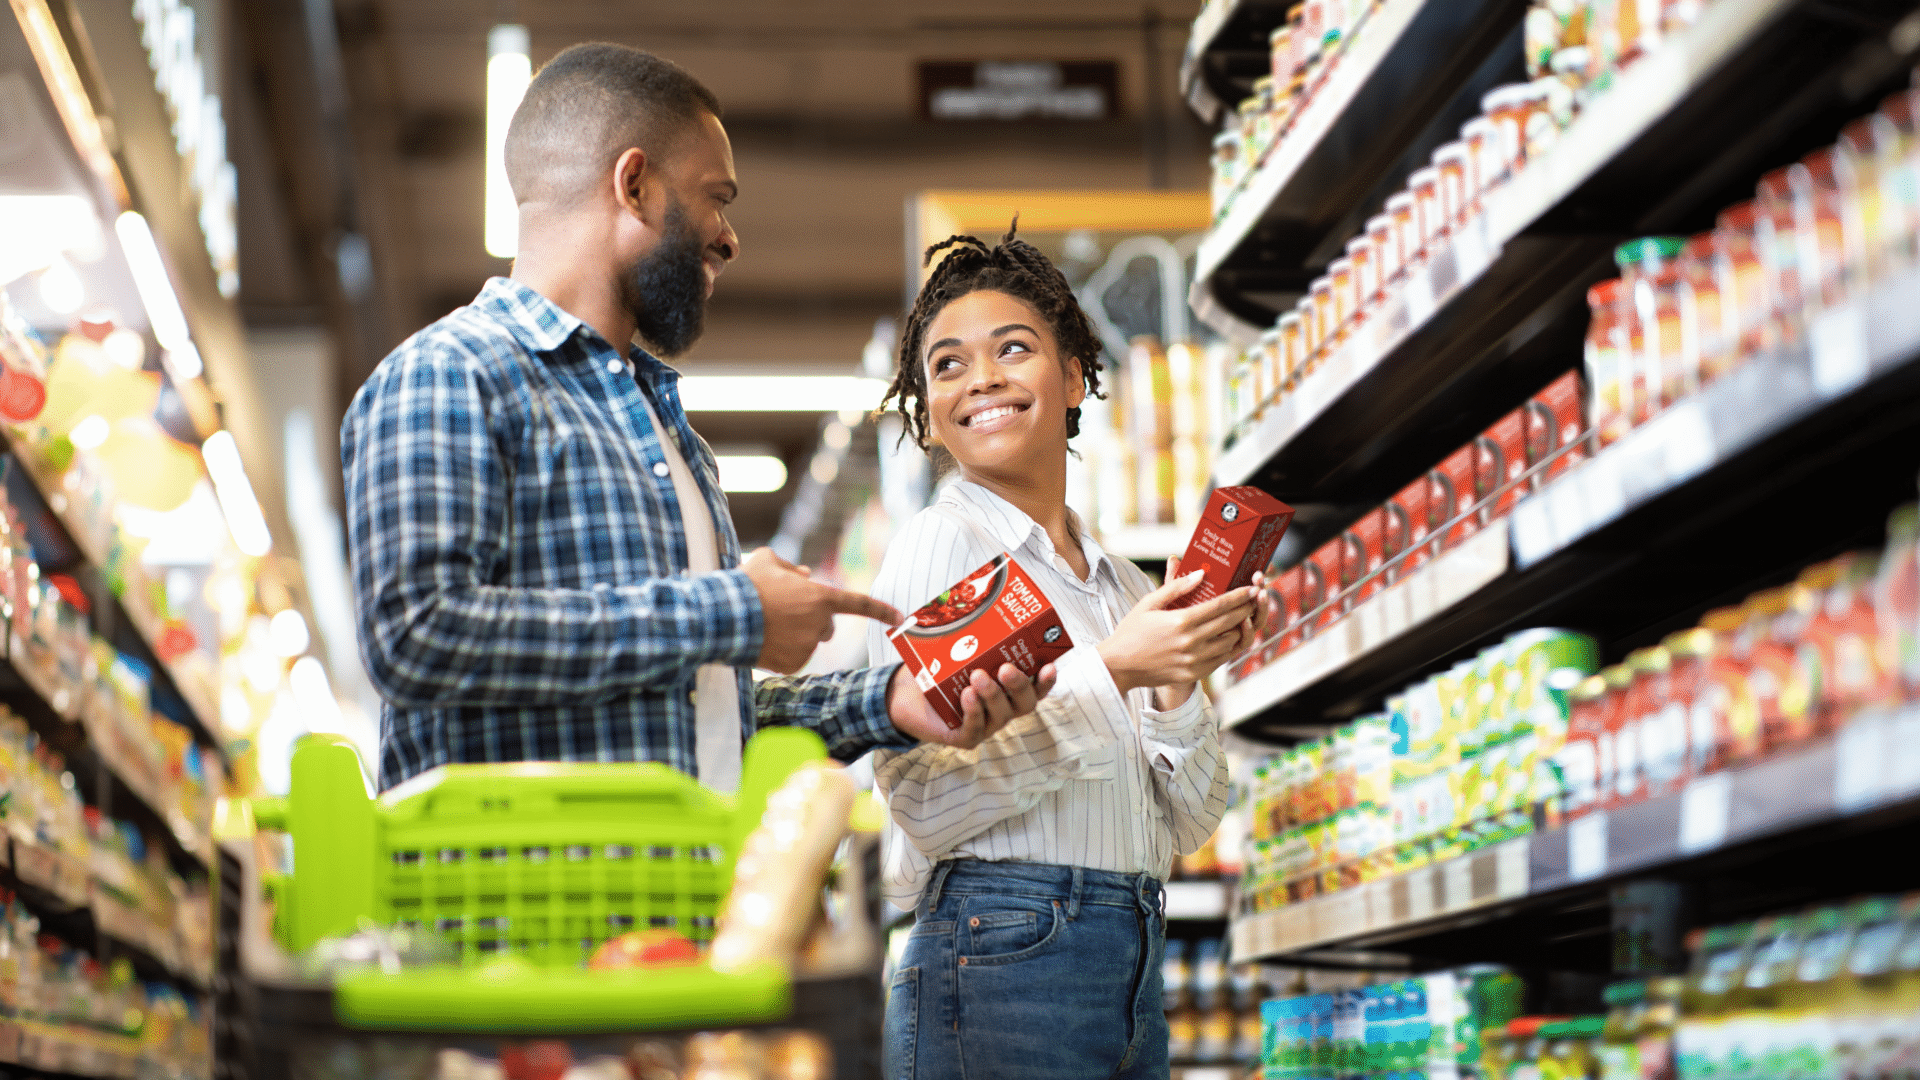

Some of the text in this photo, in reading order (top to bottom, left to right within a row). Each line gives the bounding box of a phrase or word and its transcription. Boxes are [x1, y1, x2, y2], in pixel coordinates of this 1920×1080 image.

[1203, 528, 1220, 542] Only
[1193, 540, 1209, 554] Love
[1216, 546, 1230, 557] and
[1008, 576, 1042, 613] TOMATO
[1001, 592, 1031, 623] SAUCE
[1017, 639, 1028, 655] Only
